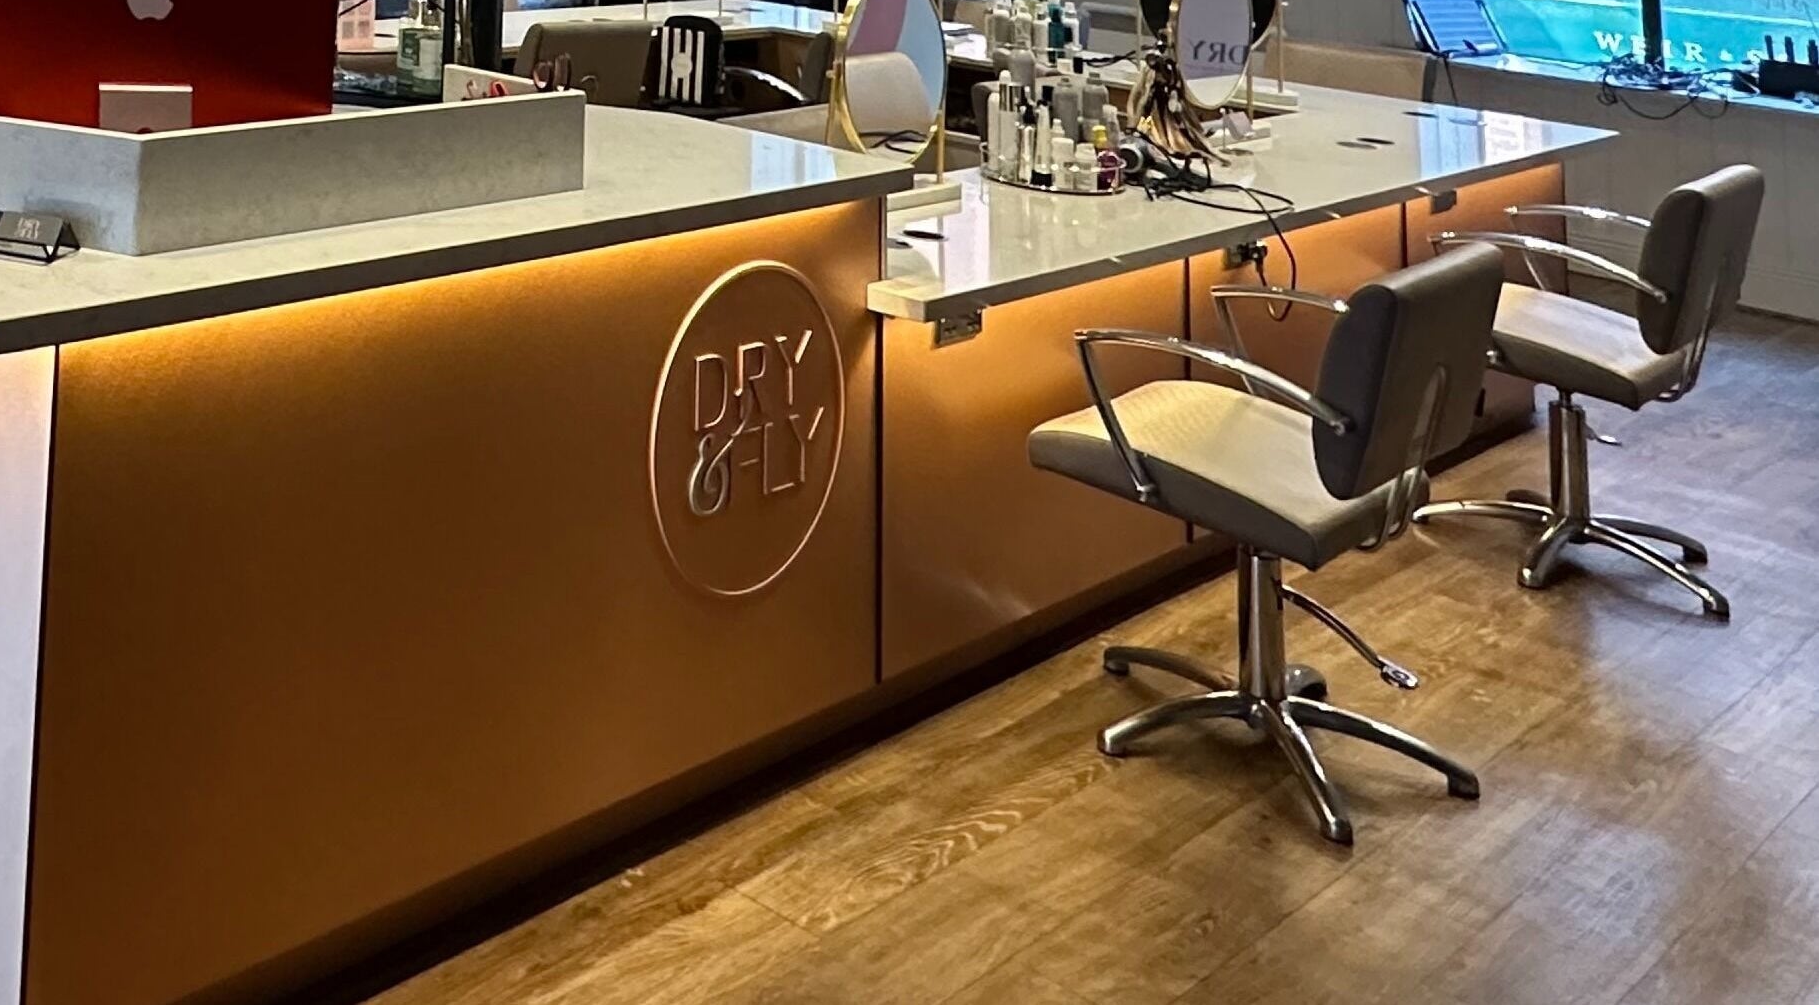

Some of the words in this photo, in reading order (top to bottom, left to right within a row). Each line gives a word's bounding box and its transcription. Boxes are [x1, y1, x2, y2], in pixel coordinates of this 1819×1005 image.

[693, 329, 813, 432] DRY
[688, 388, 752, 516] &
[727, 405, 825, 506] FLY
